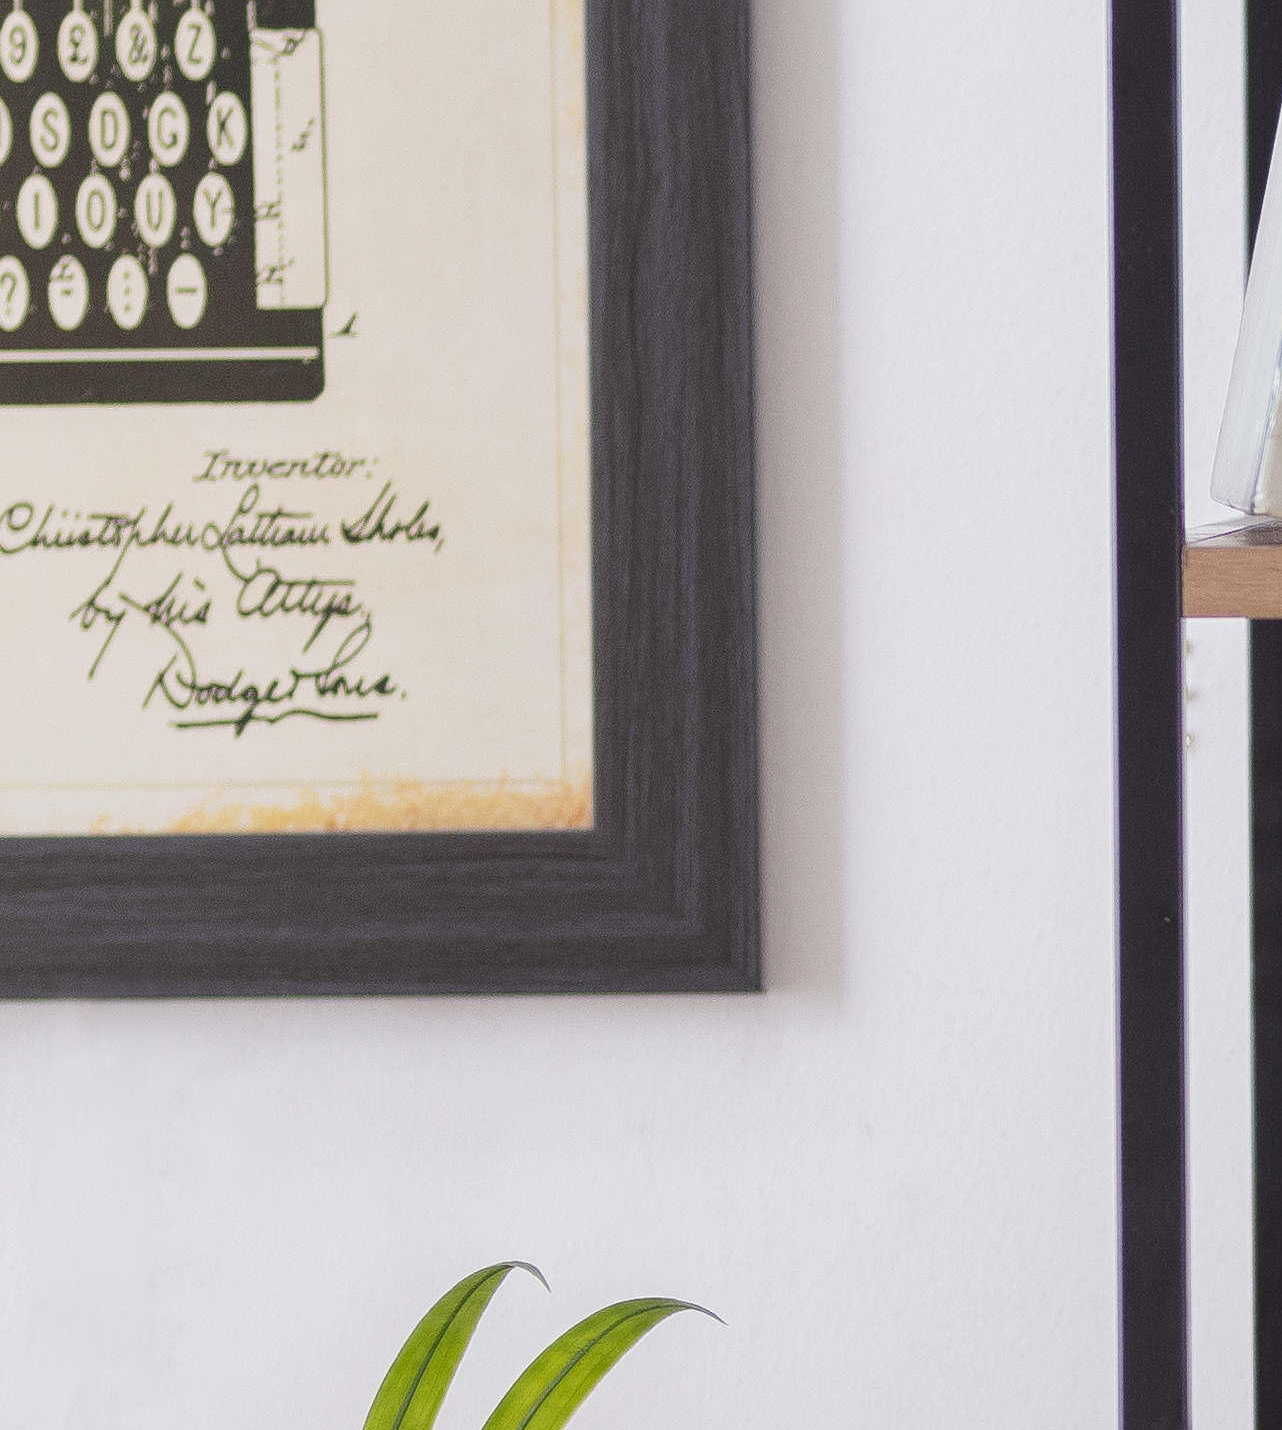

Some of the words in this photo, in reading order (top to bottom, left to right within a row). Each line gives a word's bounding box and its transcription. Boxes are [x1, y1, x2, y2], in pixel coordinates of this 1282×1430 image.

[39, 106, 61, 152] S
[99, 107, 120, 151] D
[156, 105, 179, 149] G
[215, 105, 235, 150] K
[85, 188, 105, 232] O
[145, 188, 165, 232] U
[202, 187, 224, 231] Y
[193, 450, 379, 482] Inventor:
